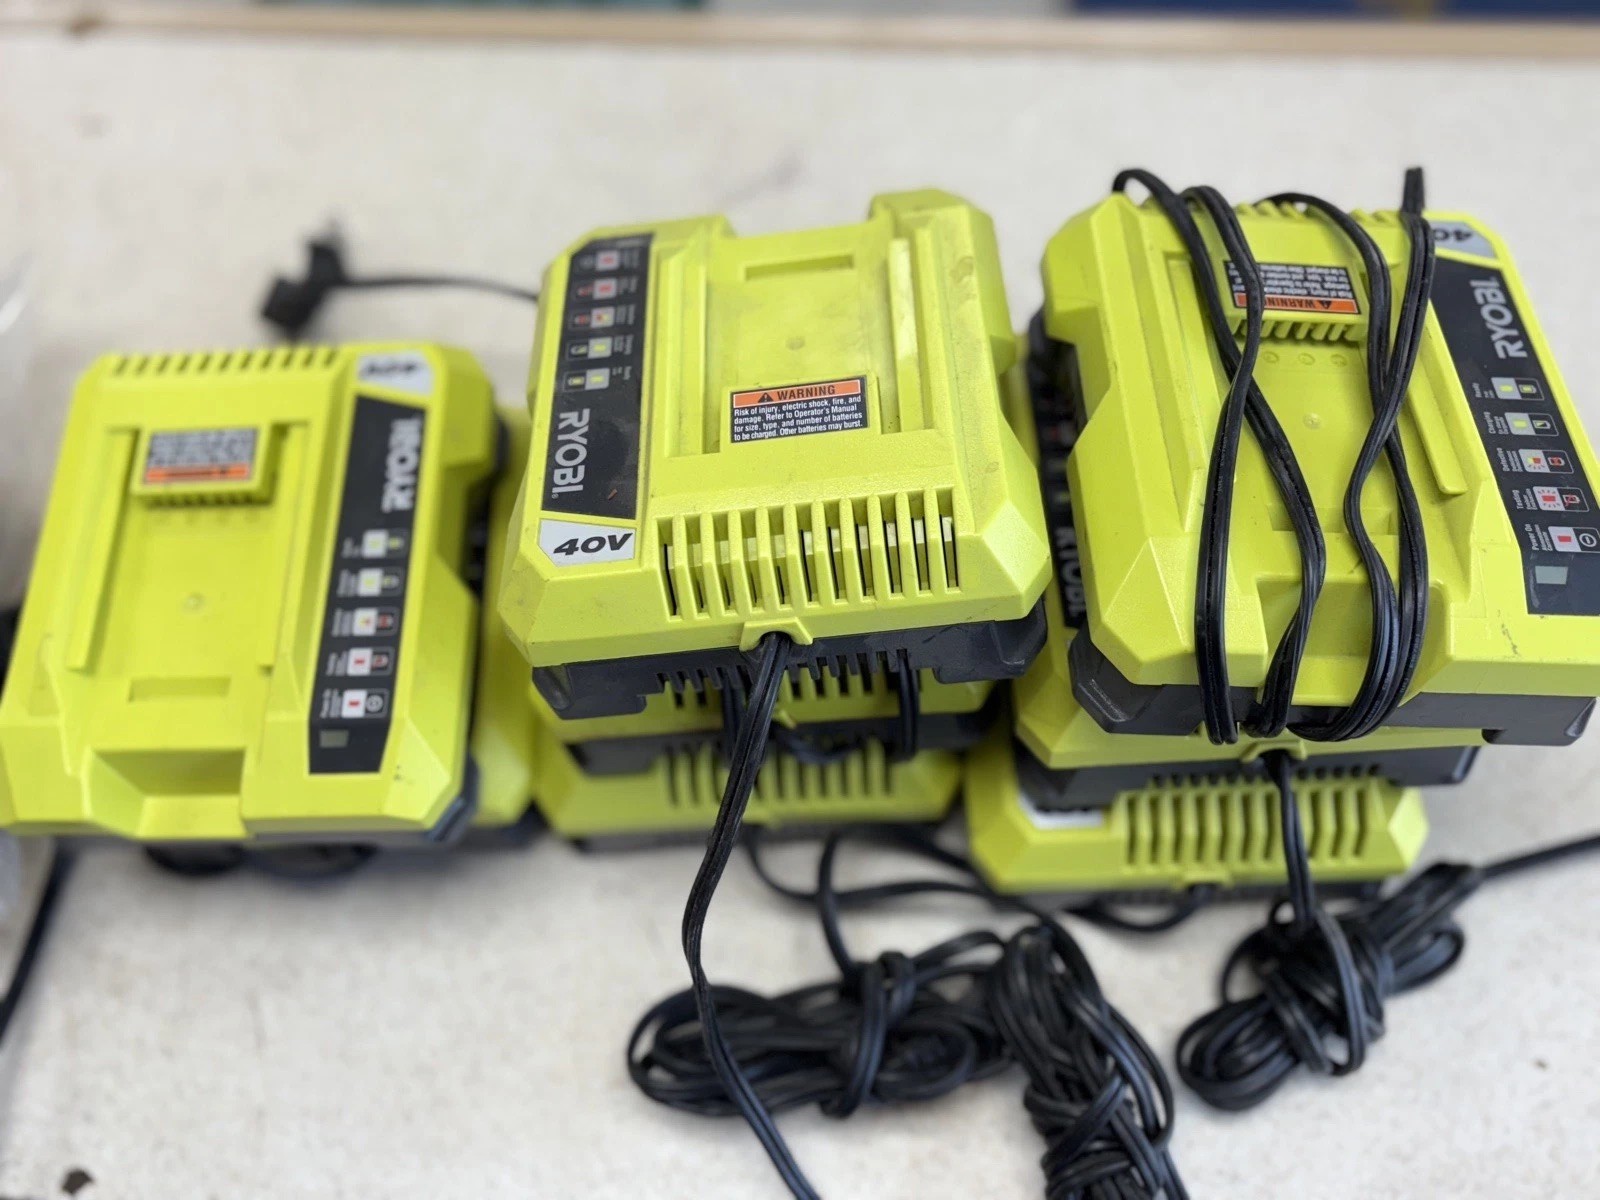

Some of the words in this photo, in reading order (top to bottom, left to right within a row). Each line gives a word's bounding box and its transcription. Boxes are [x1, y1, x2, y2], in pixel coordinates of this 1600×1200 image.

[1264, 297, 1317, 308] WARNIN
[1470, 279, 1528, 359] RYOBI
[777, 385, 835, 400] WARNING
[734, 408, 749, 417] Risk
[751, 407, 758, 415] of
[759, 406, 780, 415] injury,
[782, 401, 808, 411] electric
[809, 399, 831, 408] shock,
[832, 397, 846, 405] fire,
[848, 395, 862, 404] and
[734, 416, 763, 425] damage.
[766, 412, 784, 421] Refer
[786, 411, 793, 419] to
[794, 407, 830, 419] Operator's
[831, 404, 857, 414] Manual
[734, 425, 744, 433] for
[745, 423, 761, 432] size,
[763, 421, 780, 431] type,
[782, 419, 795, 427] and
[796, 416, 822, 426] number
[824, 414, 831, 422] of
[832, 412, 863, 421] batteries
[734, 433, 741, 441] to
[742, 432, 750, 440] be
[751, 430, 778, 440] charged.
[780, 427, 797, 436] Other
[798, 424, 827, 434] batteries
[828, 422, 842, 432] may
[843, 420, 863, 429] burst.
[552, 408, 590, 494] RYOBI
[380, 418, 422, 513] RYOBI
[1512, 489, 1523, 509] Testing
[553, 532, 633, 556] 40V
[1528, 532, 1540, 551] Power
